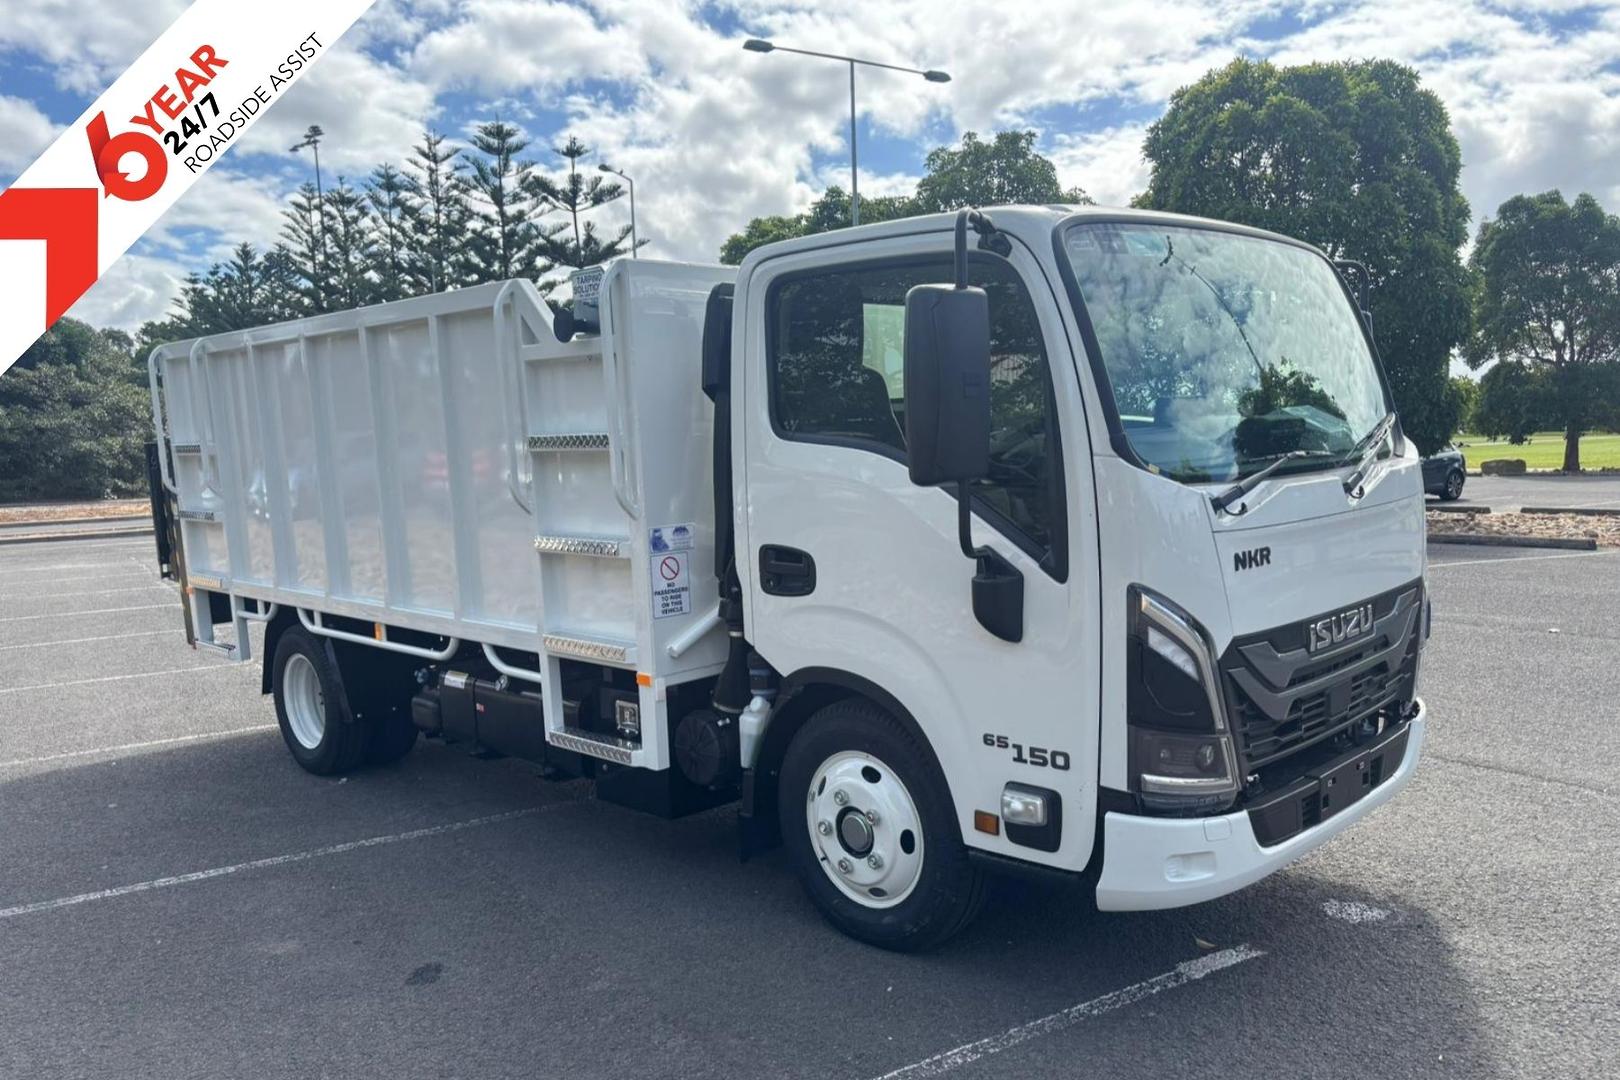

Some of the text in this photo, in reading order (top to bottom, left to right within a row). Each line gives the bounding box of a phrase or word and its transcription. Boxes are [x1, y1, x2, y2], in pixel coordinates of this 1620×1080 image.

[1234, 546, 1272, 571] NKR
[654, 587, 688, 596] PASSENGERS
[661, 606, 683, 615] VEHICLE
[1310, 604, 1373, 652] ISUZU
[983, 733, 1070, 771] 65 150
